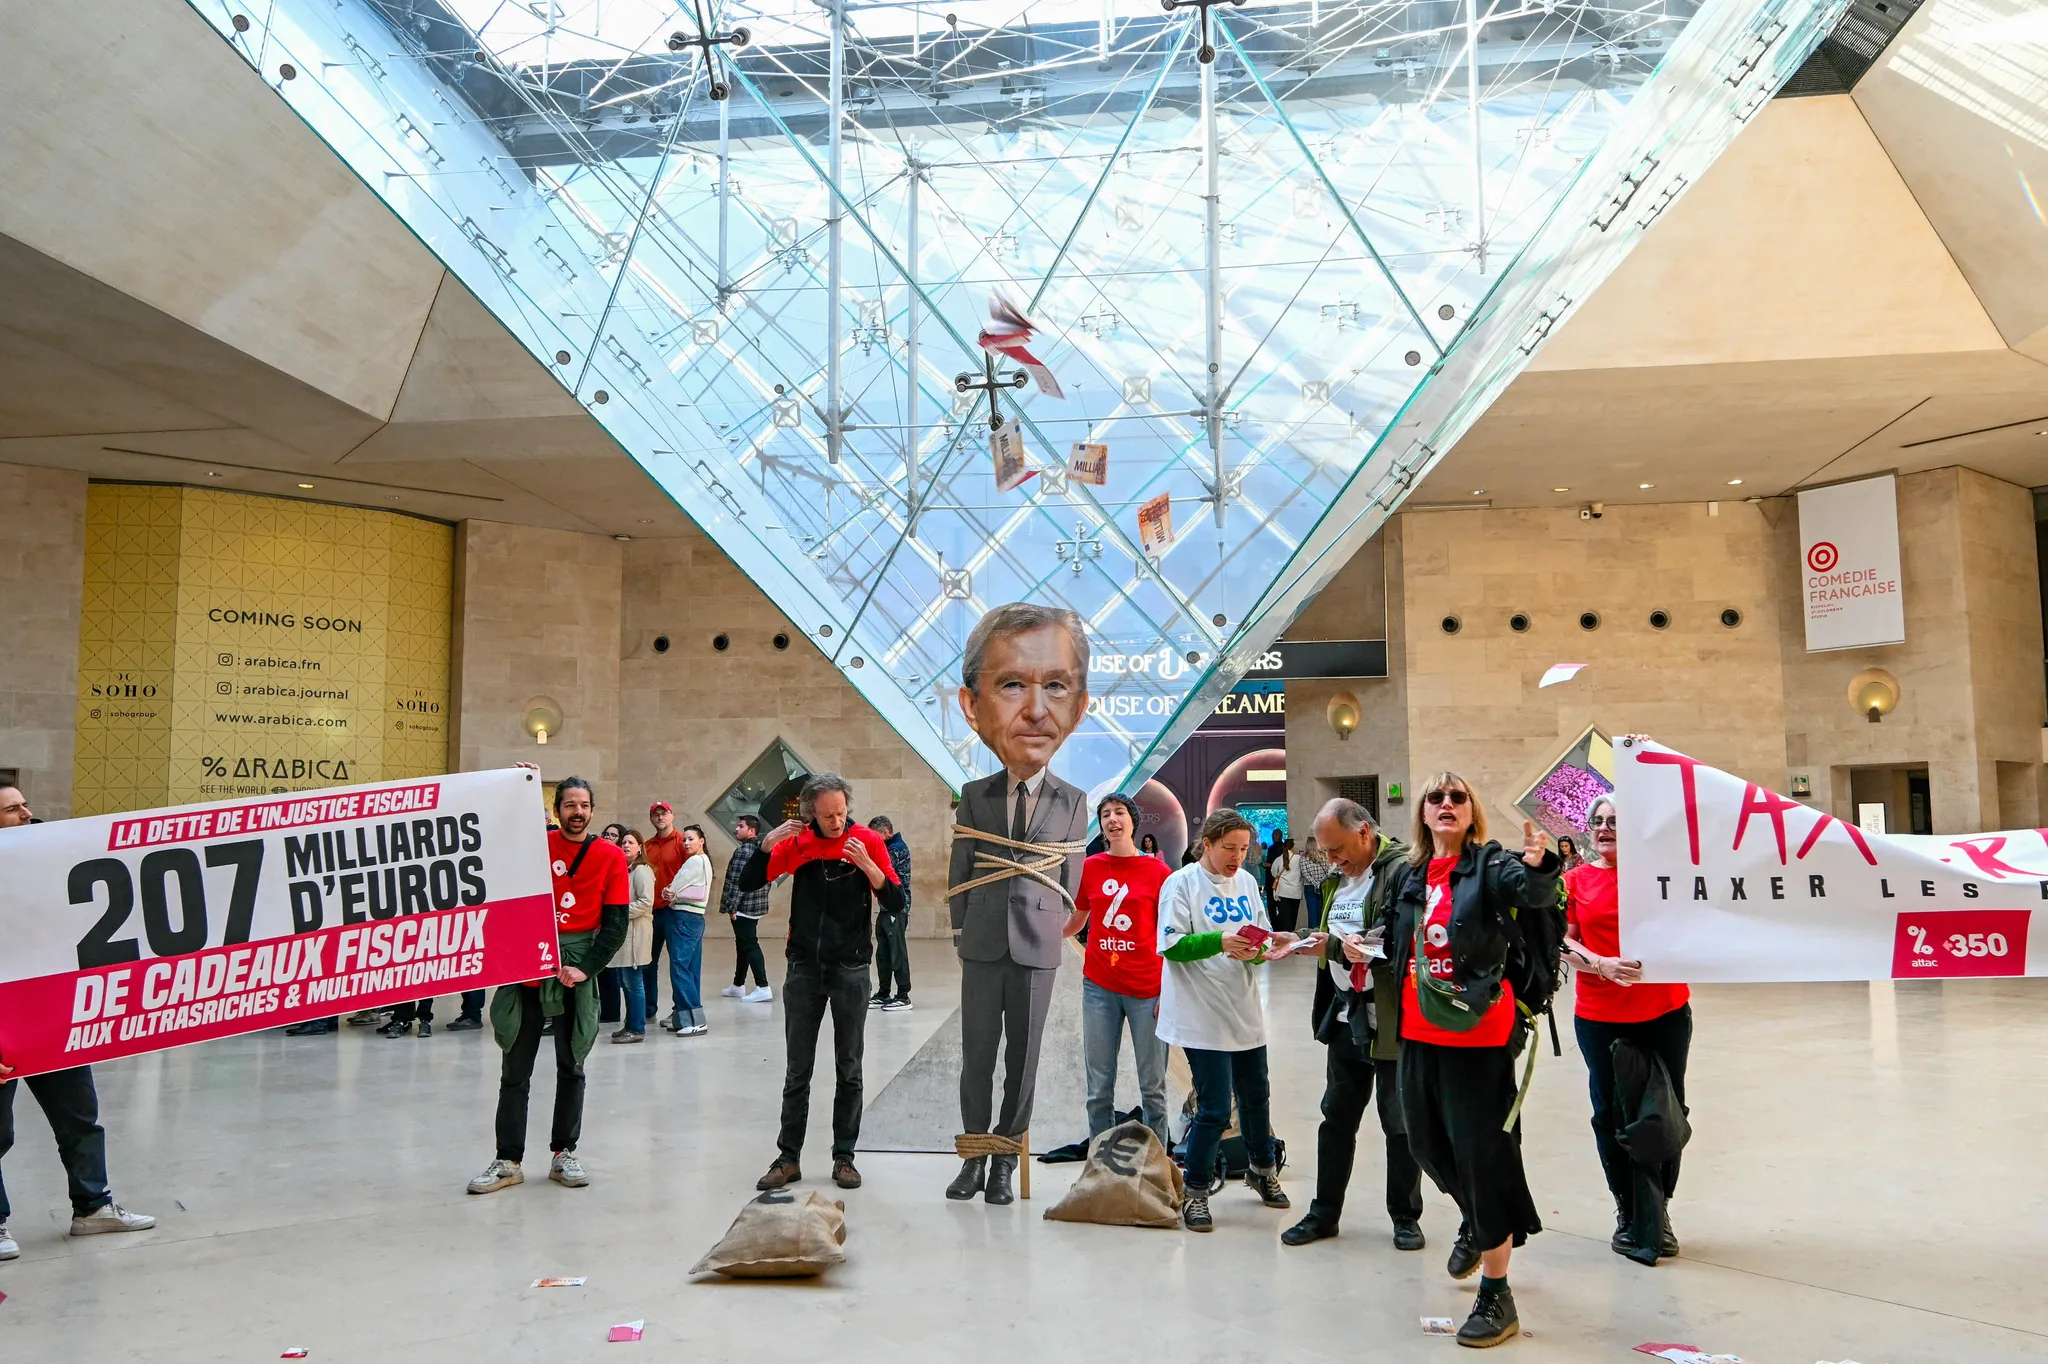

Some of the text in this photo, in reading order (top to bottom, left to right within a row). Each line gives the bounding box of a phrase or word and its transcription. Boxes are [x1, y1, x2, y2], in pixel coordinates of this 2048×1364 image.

[1808, 568, 1877, 589] COMÉDIE
[1809, 581, 1896, 602] FRANÇAISE
[208, 608, 362, 633] COMING SOON
[244, 655, 321, 671] arabica.frn
[1128, 654, 1156, 673] OF
[91, 684, 156, 697] SOHO
[243, 683, 349, 702] arabica.journal
[396, 699, 439, 713] SOHO
[1086, 696, 1144, 715] OUSE
[1146, 695, 1178, 715] OF
[215, 711, 348, 728] www.arabica.com
[233, 757, 349, 780] ARABICA
[200, 785, 267, 795] SEE THE WORLD
[115, 787, 435, 847] LA DETTE DE L'INJUSTICE FISCALE
[67, 812, 482, 970] 207 MILLIARDS
[288, 855, 487, 934] D'EUROS
[1656, 874, 1980, 901] TAXER LES
[1208, 895, 1253, 924] 350
[1099, 936, 1136, 951] attac
[1949, 932, 2009, 958] 350
[71, 908, 489, 1024] DE CADEAUX FISCAUX
[1409, 957, 1453, 973] aac
[1911, 958, 1938, 967] attac
[64, 952, 484, 1053] AUX ULTRASRICHES & MULTINATIONALES
